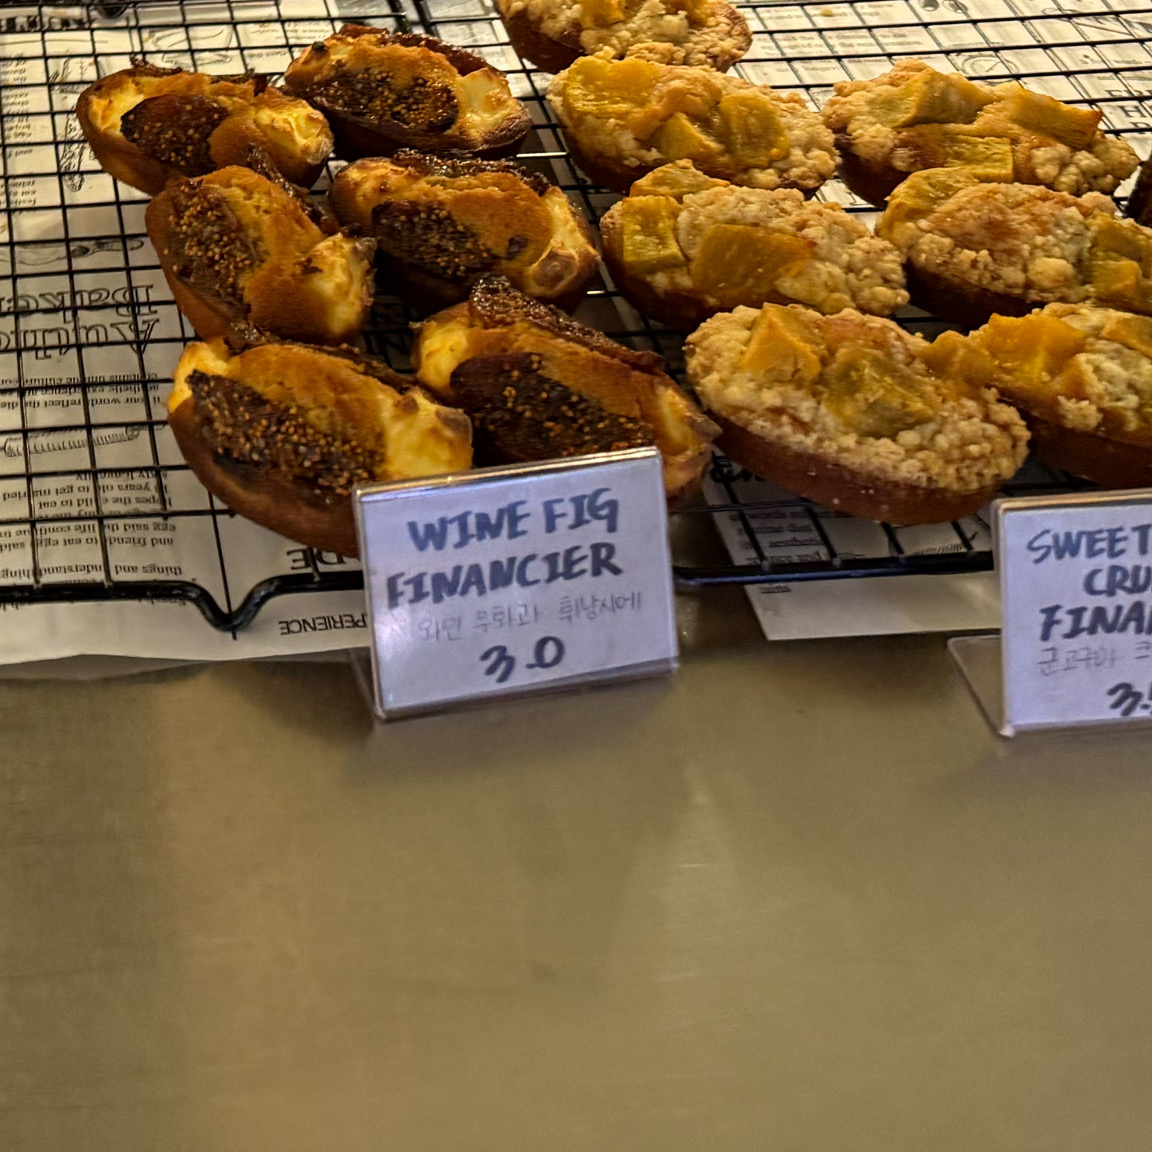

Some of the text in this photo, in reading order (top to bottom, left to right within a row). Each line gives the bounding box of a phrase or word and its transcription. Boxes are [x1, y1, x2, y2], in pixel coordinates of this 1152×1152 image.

[43, 397, 81, 410] reflect
[54, 483, 74, 498] get
[77, 485, 90, 497] to
[117, 482, 150, 495] years
[38, 499, 57, 511] eat
[60, 498, 73, 510] to
[112, 496, 132, 509] the
[407, 488, 619, 552] WINE FIG
[0, 530, 11, 540] to
[73, 523, 96, 536] life
[124, 523, 149, 536] said
[0, 541, 25, 554] said
[63, 537, 82, 549] eat
[86, 536, 98, 547] to
[152, 536, 174, 548] and
[1028, 524, 1152, 564] SWEET
[39, 564, 106, 579] nderstand
[115, 565, 138, 577] and
[142, 564, 182, 577] things
[387, 542, 623, 610] FINANCIER
